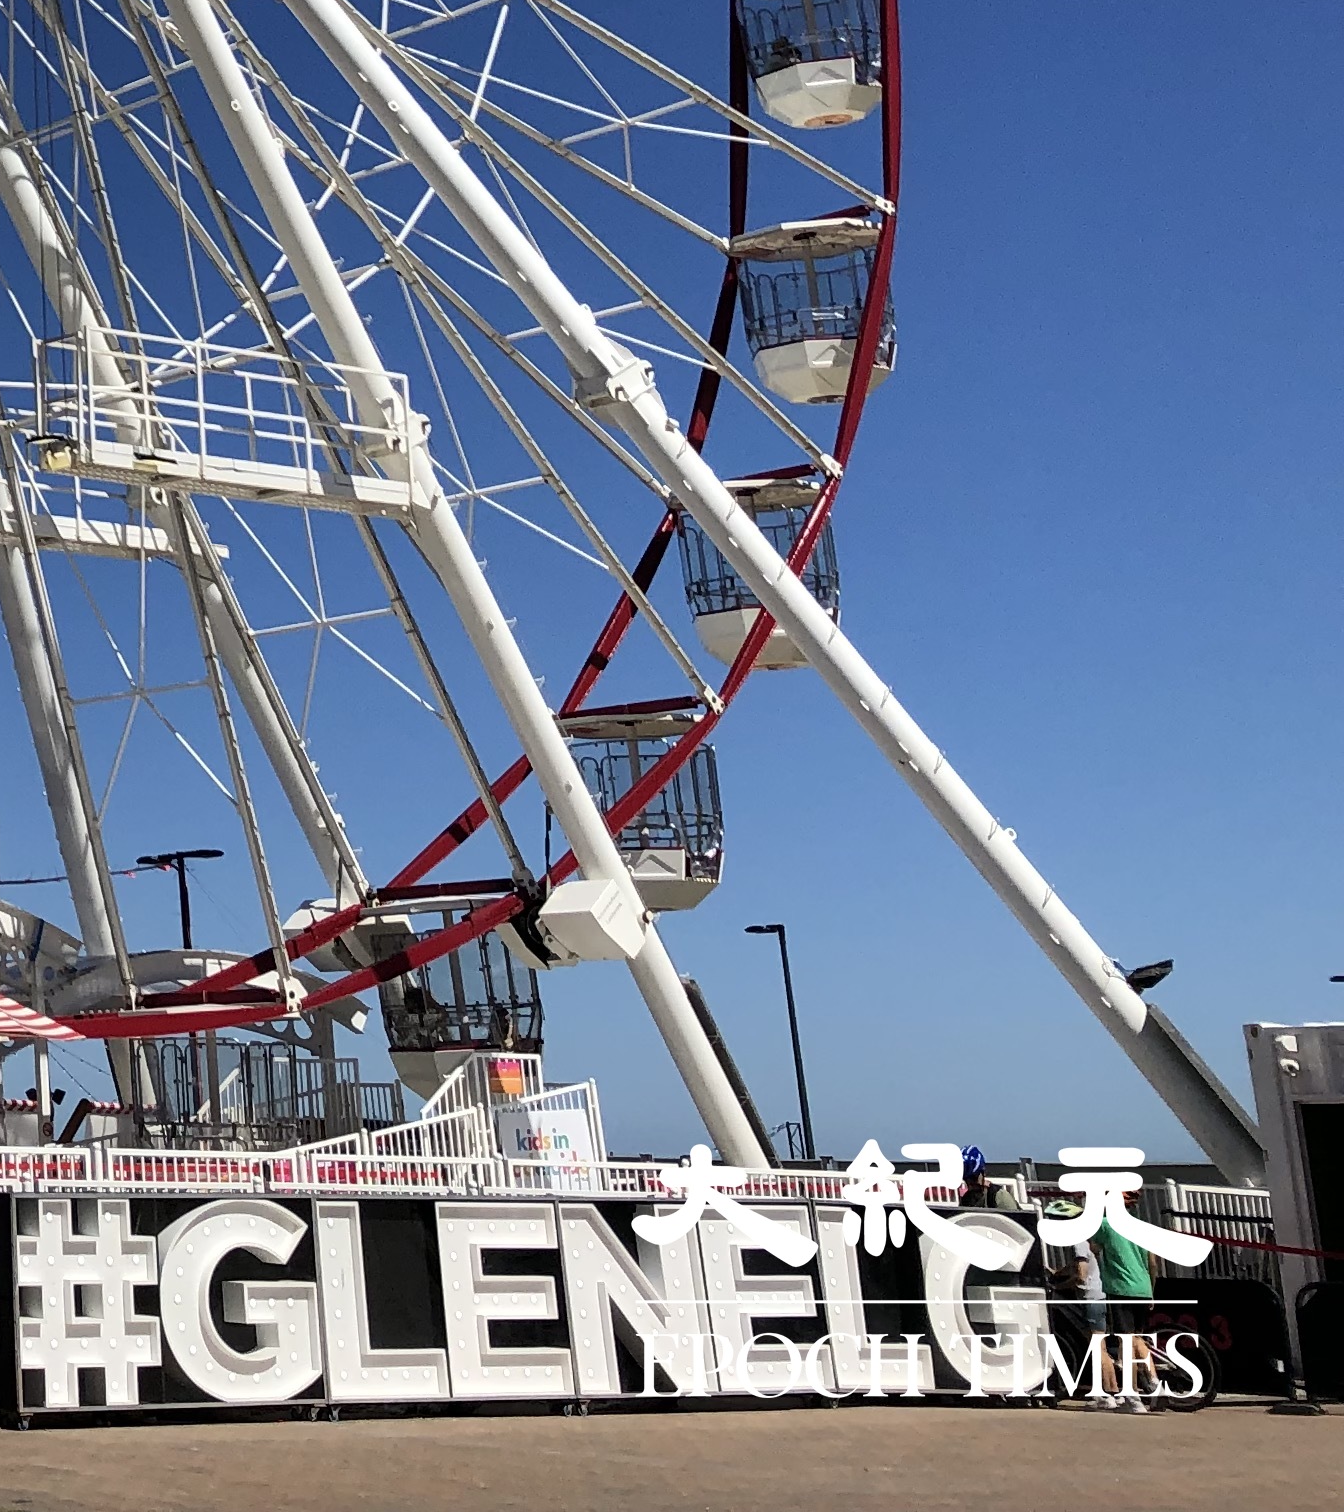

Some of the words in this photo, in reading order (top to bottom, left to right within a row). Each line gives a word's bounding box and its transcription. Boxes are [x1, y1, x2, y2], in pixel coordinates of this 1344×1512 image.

[515, 1127, 552, 1151] kids
[551, 1127, 570, 1150] in
[15, 1197, 1054, 1408] #GLENELG
